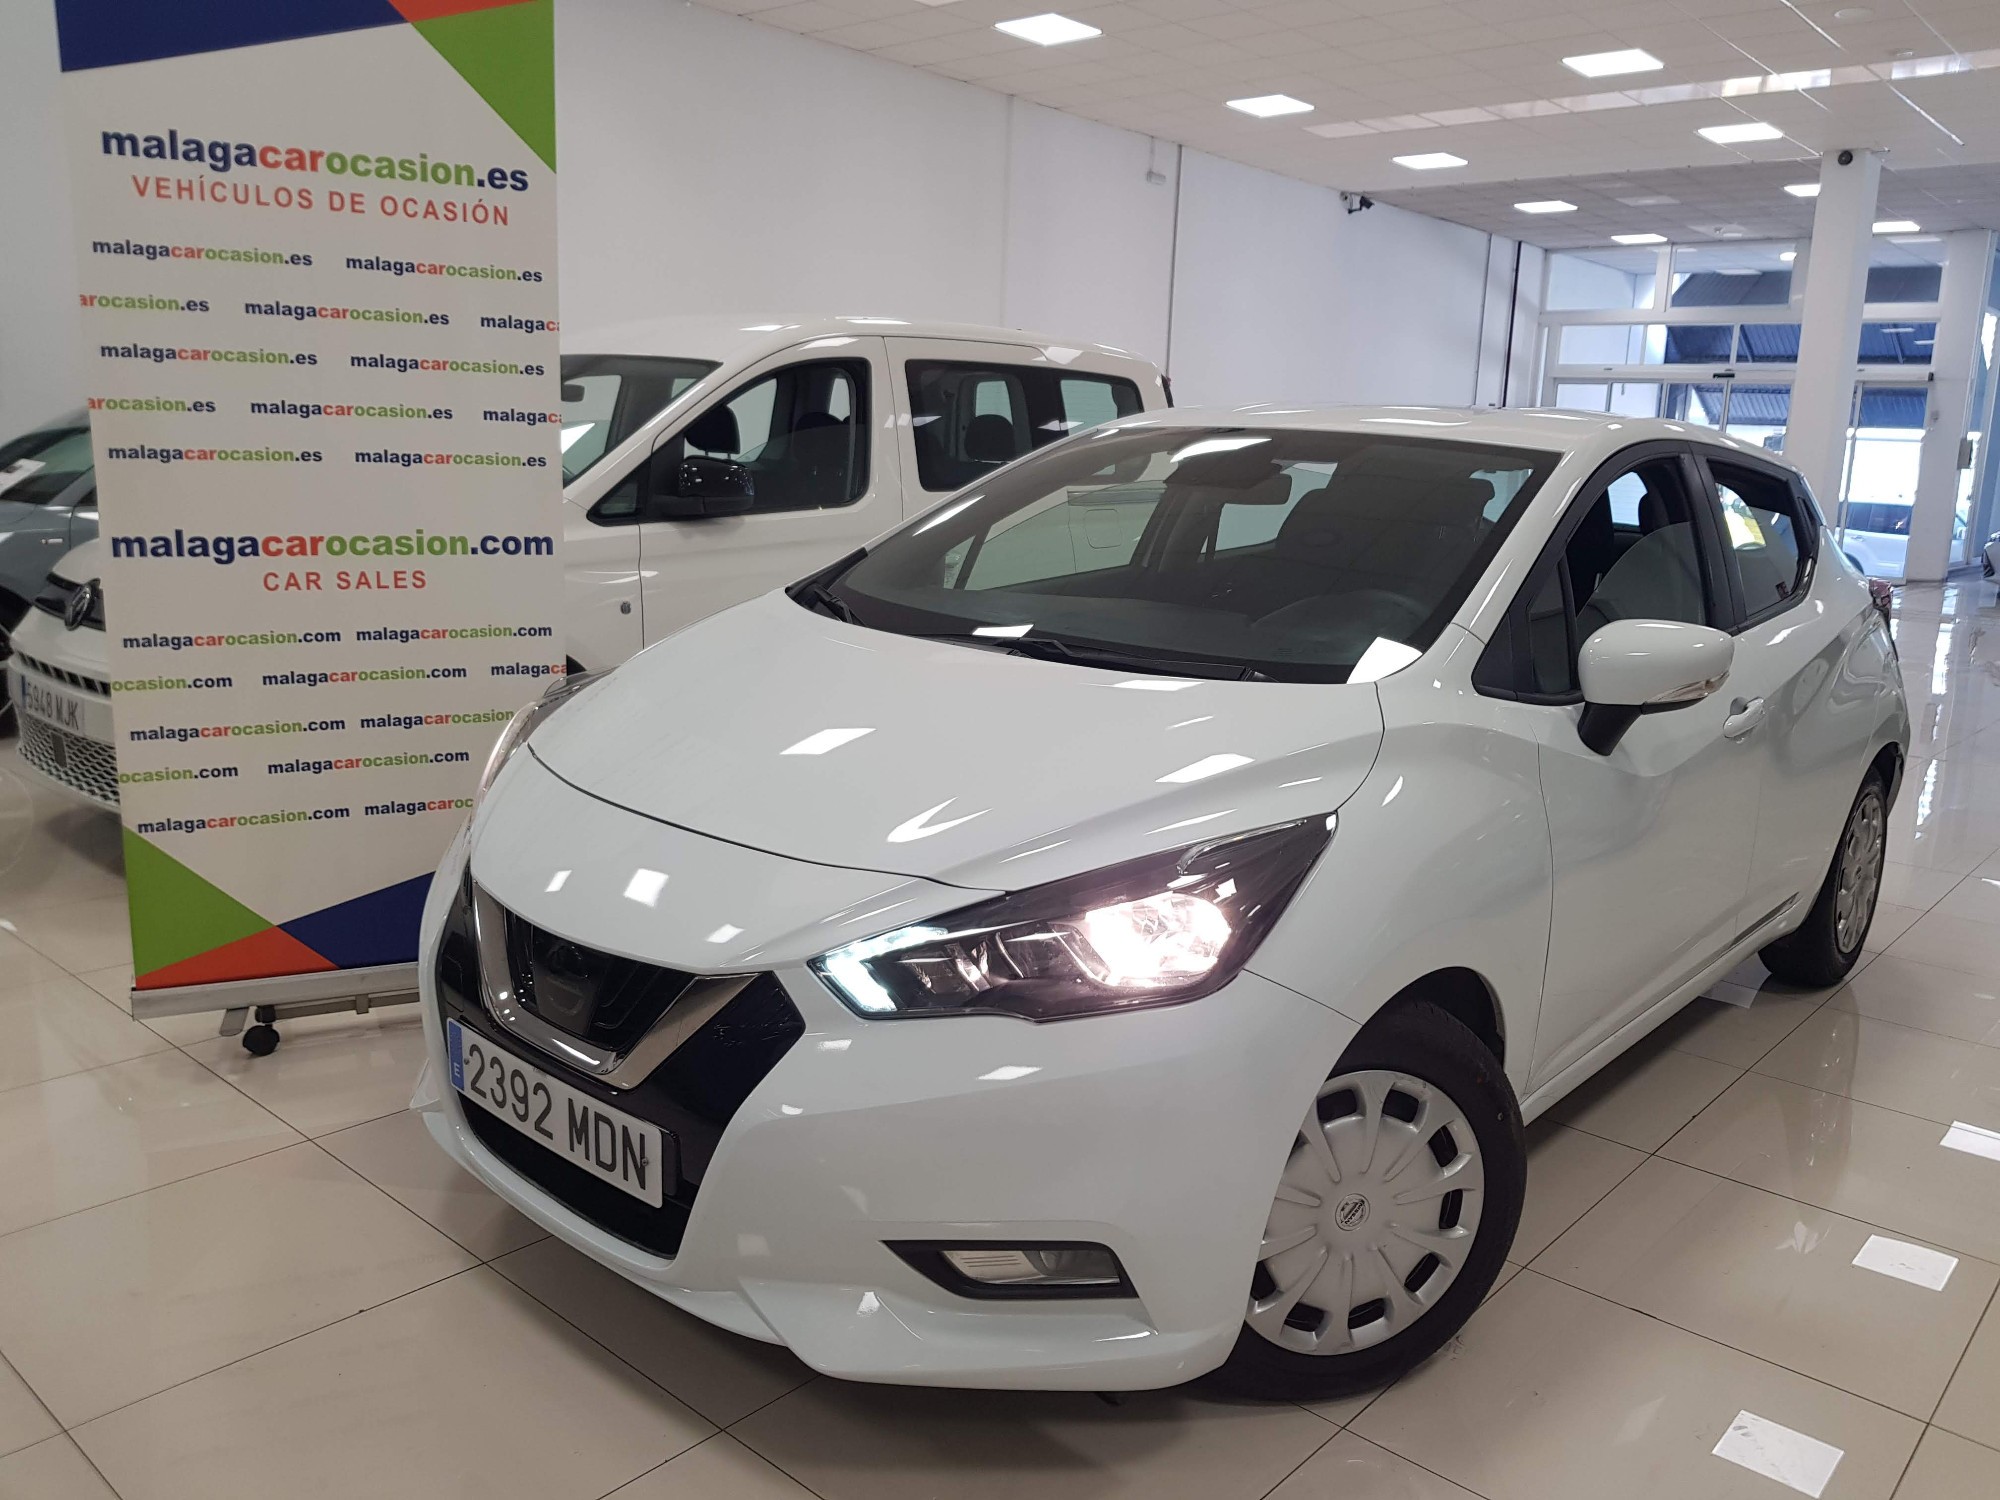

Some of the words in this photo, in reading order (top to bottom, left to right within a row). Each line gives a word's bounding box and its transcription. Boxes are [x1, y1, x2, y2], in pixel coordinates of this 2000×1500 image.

[101, 128, 529, 191] malagacarocasion.es
[131, 174, 314, 210] VEHÍCULOS
[328, 190, 366, 214] DE
[380, 195, 508, 226] OCASIÓN
[92, 239, 313, 267] malagacarocasion.es
[345, 255, 543, 283] malagacarocasion.es
[244, 300, 450, 326] malagacarocasion.es
[100, 342, 318, 366] malagacarocasion.es
[350, 353, 545, 376] malagacarocasion.es
[250, 399, 454, 420] malagacarocasion.es
[107, 444, 323, 464] malagacarocasion.es
[354, 448, 547, 468] malagacarocasion.es
[111, 528, 554, 566] malagacarocasion.com
[263, 571, 323, 592] CAR
[336, 570, 427, 591] SALES
[122, 630, 342, 651] malagacarocasion.com
[356, 626, 553, 644] malagacarocasion.com
[262, 666, 468, 688] malagacarocasion.com
[129, 719, 346, 743] malagacarocasion.com
[267, 751, 470, 775] malagacarocasion.com
[137, 806, 350, 834] malagacarocasion.com
[469, 1044, 553, 1140] 2392
[567, 1097, 646, 1191] MDN
